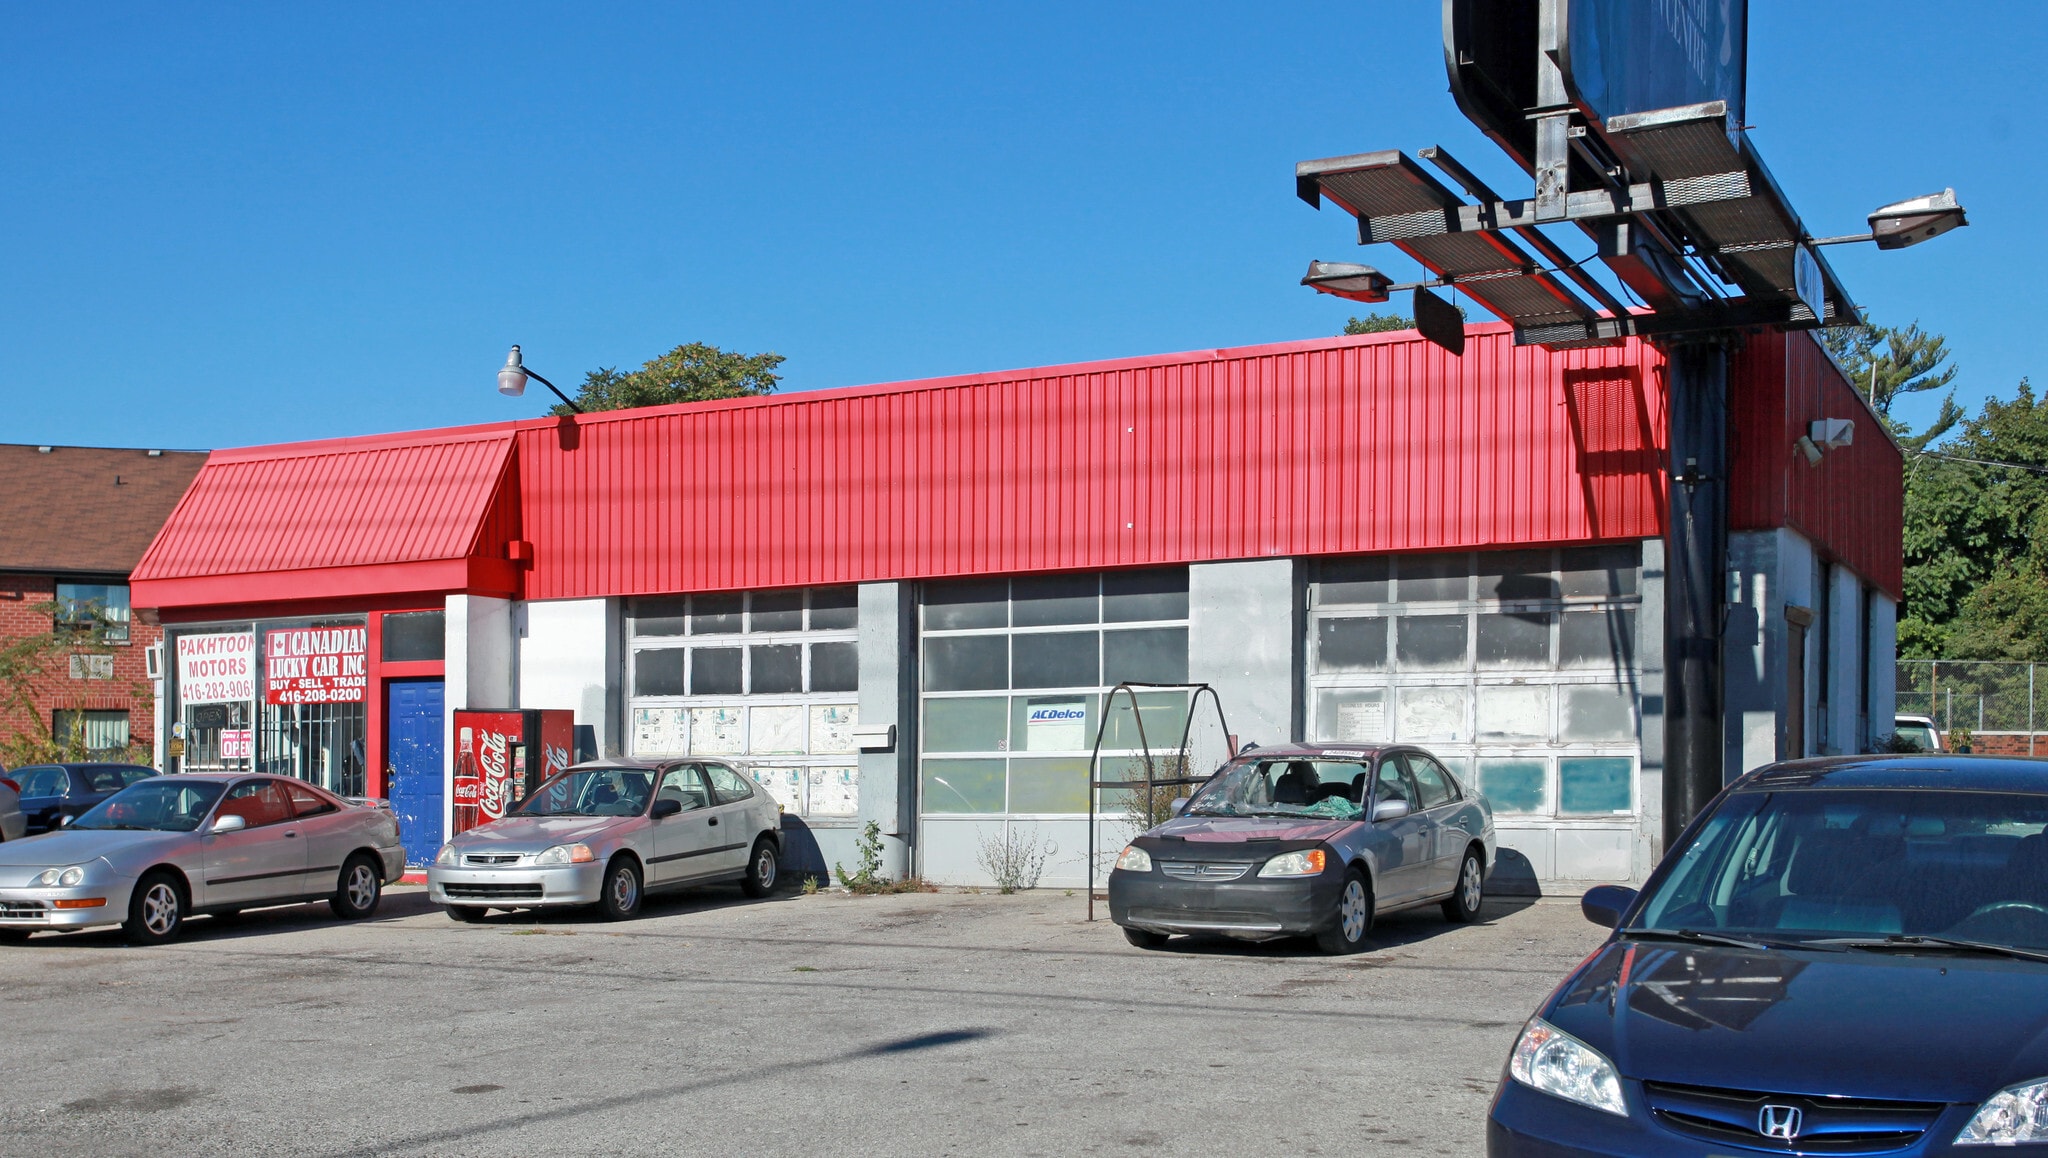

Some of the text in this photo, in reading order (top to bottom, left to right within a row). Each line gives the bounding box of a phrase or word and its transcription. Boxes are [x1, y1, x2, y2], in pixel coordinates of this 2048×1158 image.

[291, 628, 366, 655] CANADIAN
[189, 658, 247, 678] MOTORS
[269, 657, 308, 679] LUCKY
[312, 656, 338, 677] CAR
[183, 680, 253, 701] 416-282-906
[270, 679, 290, 690] BUY
[299, 678, 324, 689] SELL
[332, 676, 366, 687] TRADE
[279, 688, 361, 703] 416-208-0200
[1031, 709, 1085, 719] ACDelco
[224, 740, 251, 756] OPEN
[480, 728, 506, 819] Coca-Cola
